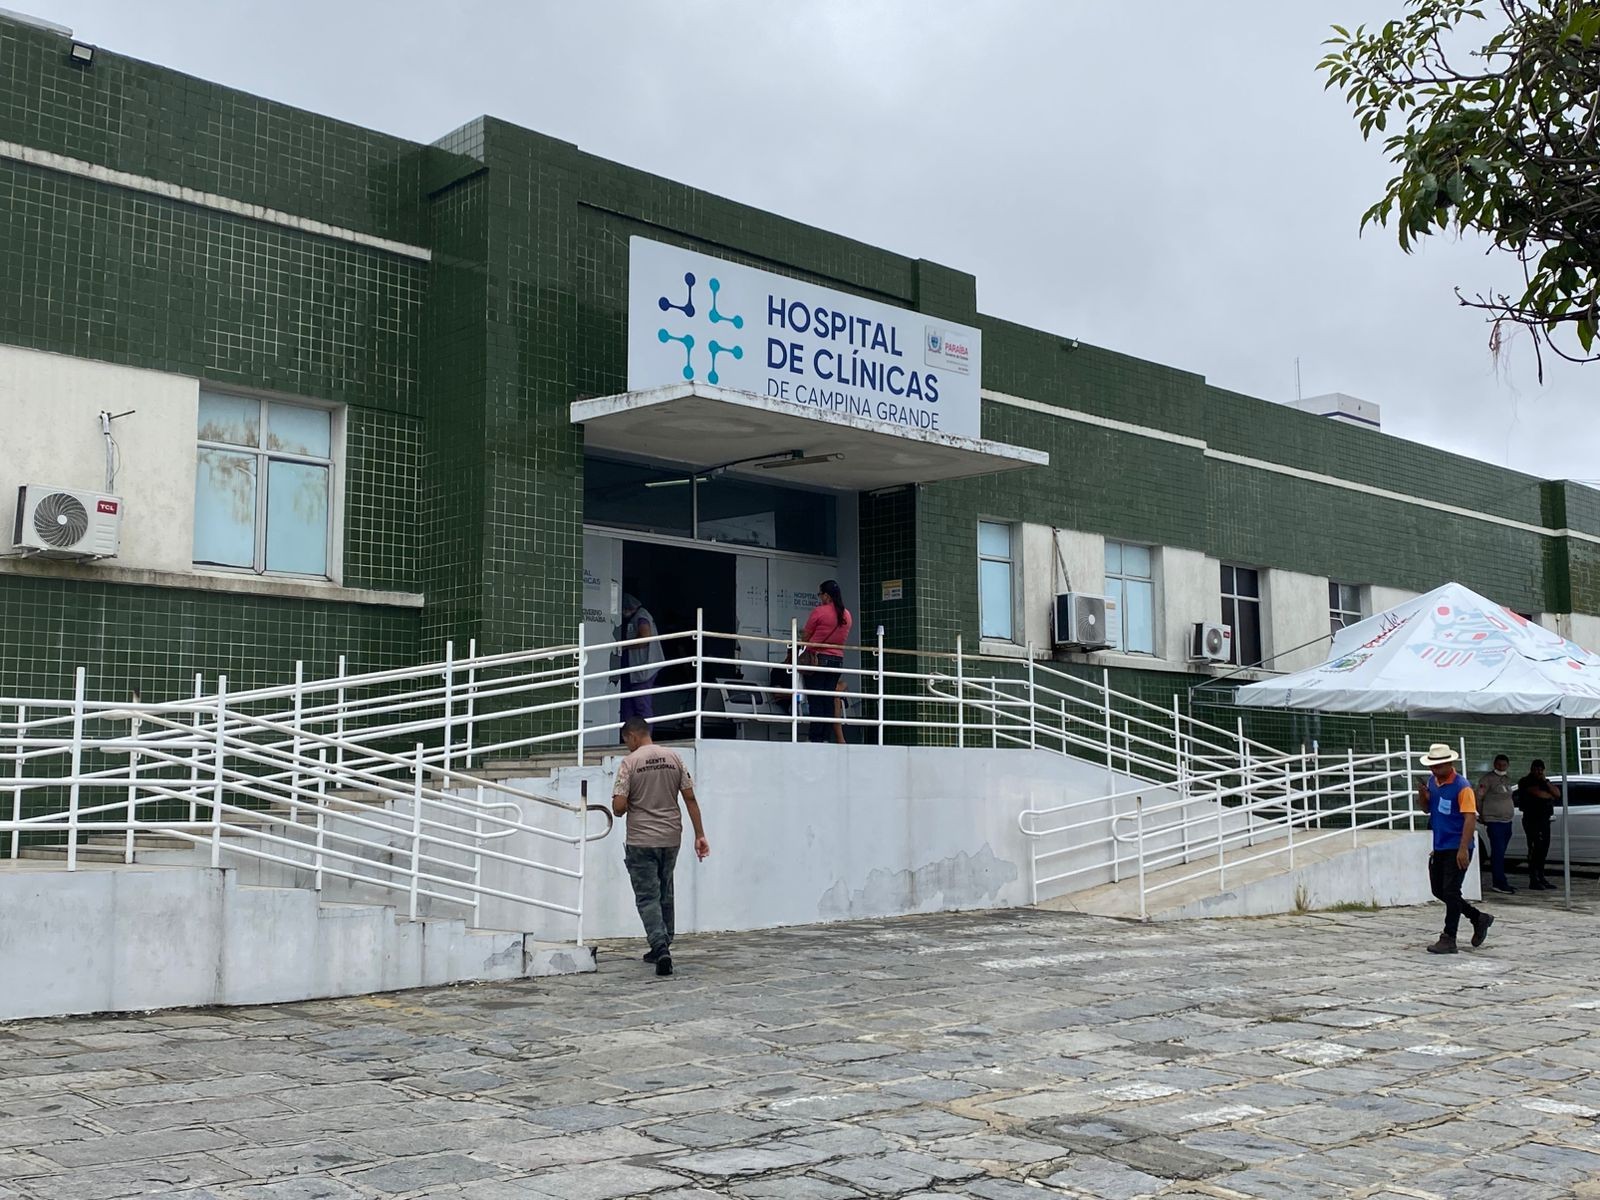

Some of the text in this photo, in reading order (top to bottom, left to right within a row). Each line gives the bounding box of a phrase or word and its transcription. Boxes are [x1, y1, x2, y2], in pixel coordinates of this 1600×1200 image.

[768, 295, 903, 357] HOSPITAL
[767, 338, 939, 402] DE CLÍNICAS
[767, 378, 939, 431] DE CAMPINA GRANDE
[100, 503, 115, 511] TCL
[636, 764, 676, 774] INSTITUCIONAL
[645, 757, 666, 765] AGENTE
